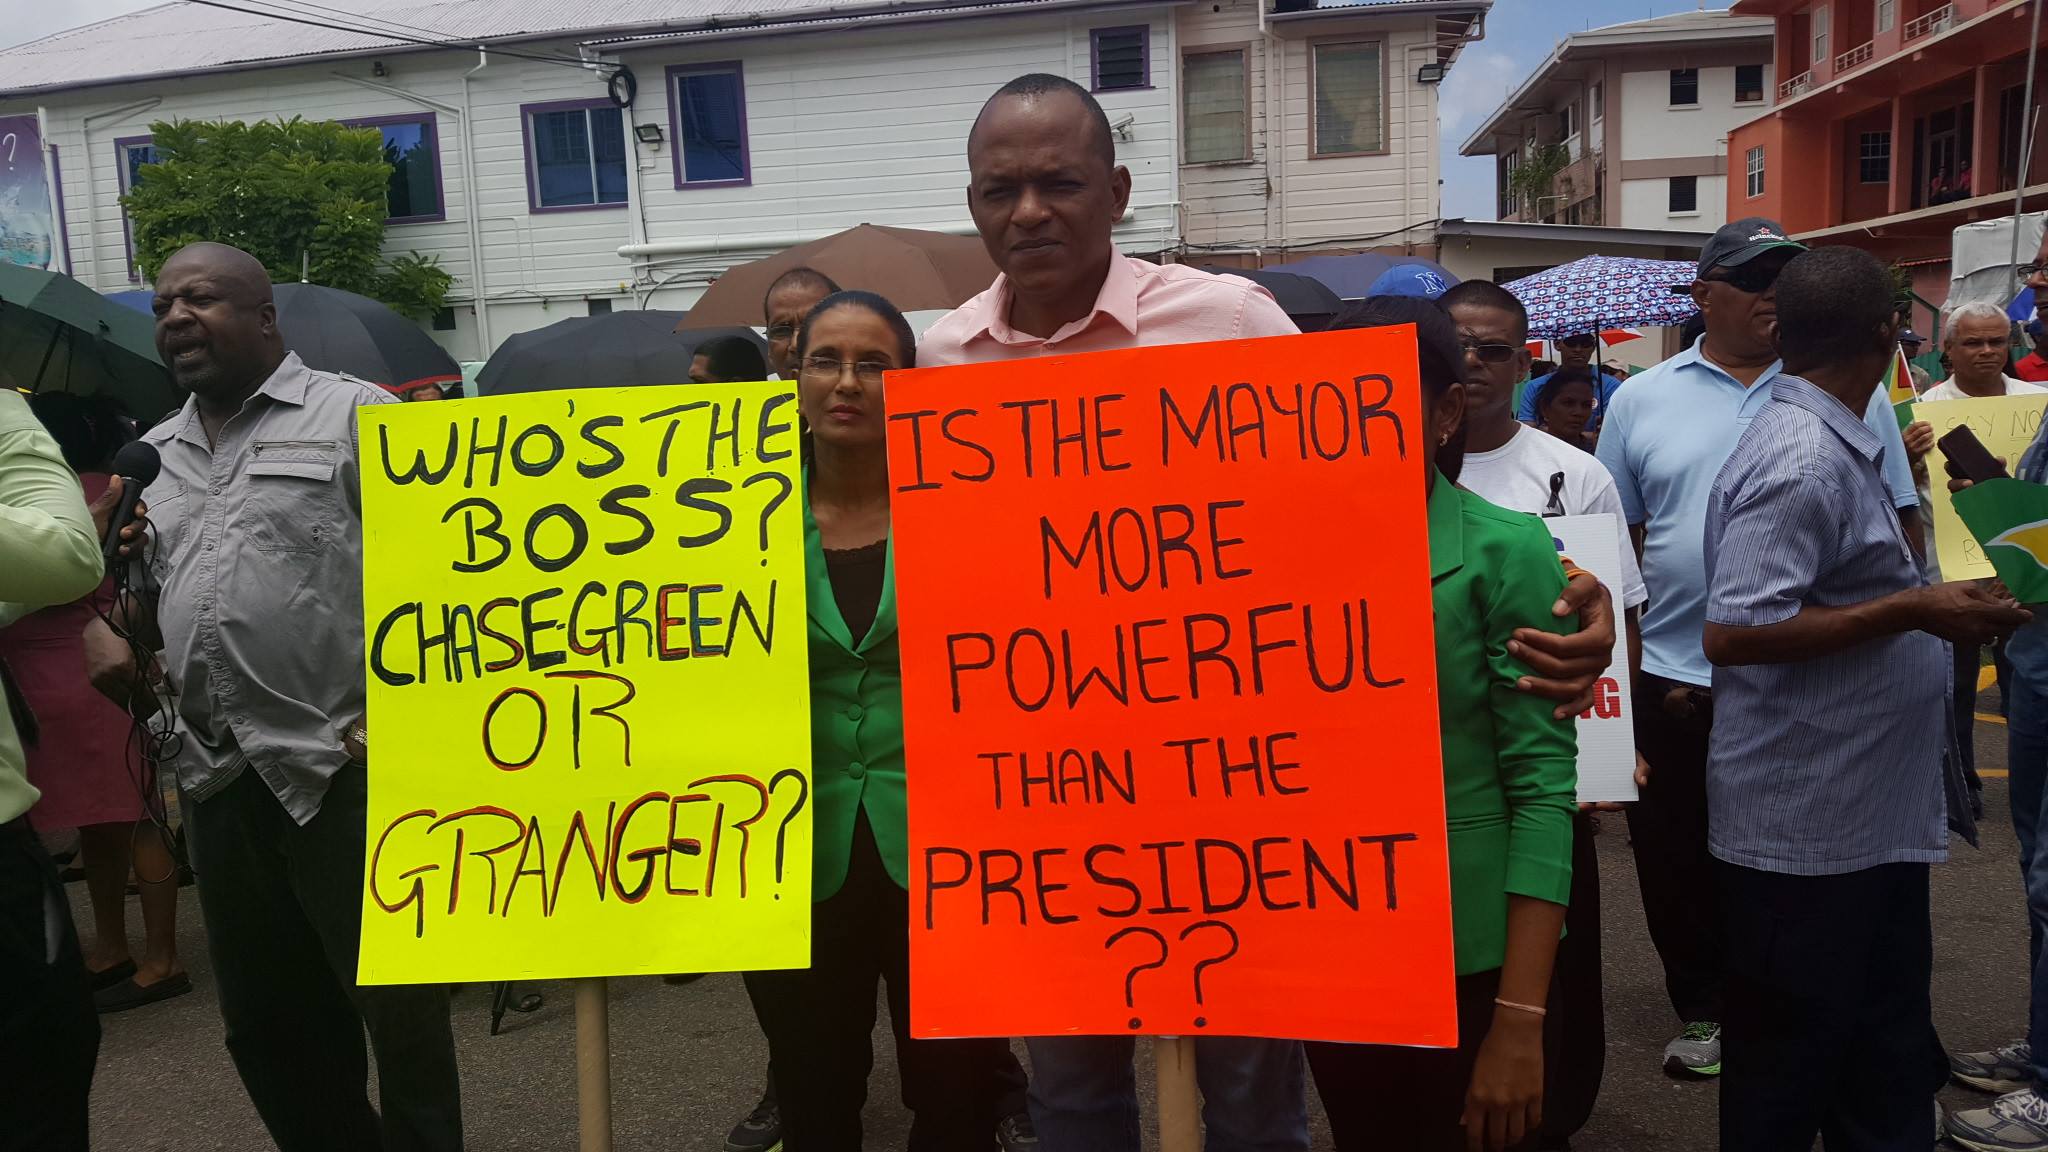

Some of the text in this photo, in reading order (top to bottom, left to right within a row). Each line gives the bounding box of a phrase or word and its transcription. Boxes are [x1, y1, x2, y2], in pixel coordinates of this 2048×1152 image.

[379, 393, 796, 488] WHO'S THE
[889, 374, 1407, 492] IS THE MAYOR
[441, 472, 793, 574] BOSS?
[1039, 500, 1253, 598] MORE
[946, 599, 1406, 713] POWERFUL
[482, 670, 636, 771] OR
[977, 732, 1309, 809] THAN THE
[370, 769, 808, 938] GRANGER?
[925, 833, 1419, 929] PRESIDENT
[1104, 920, 1240, 1030] ??
